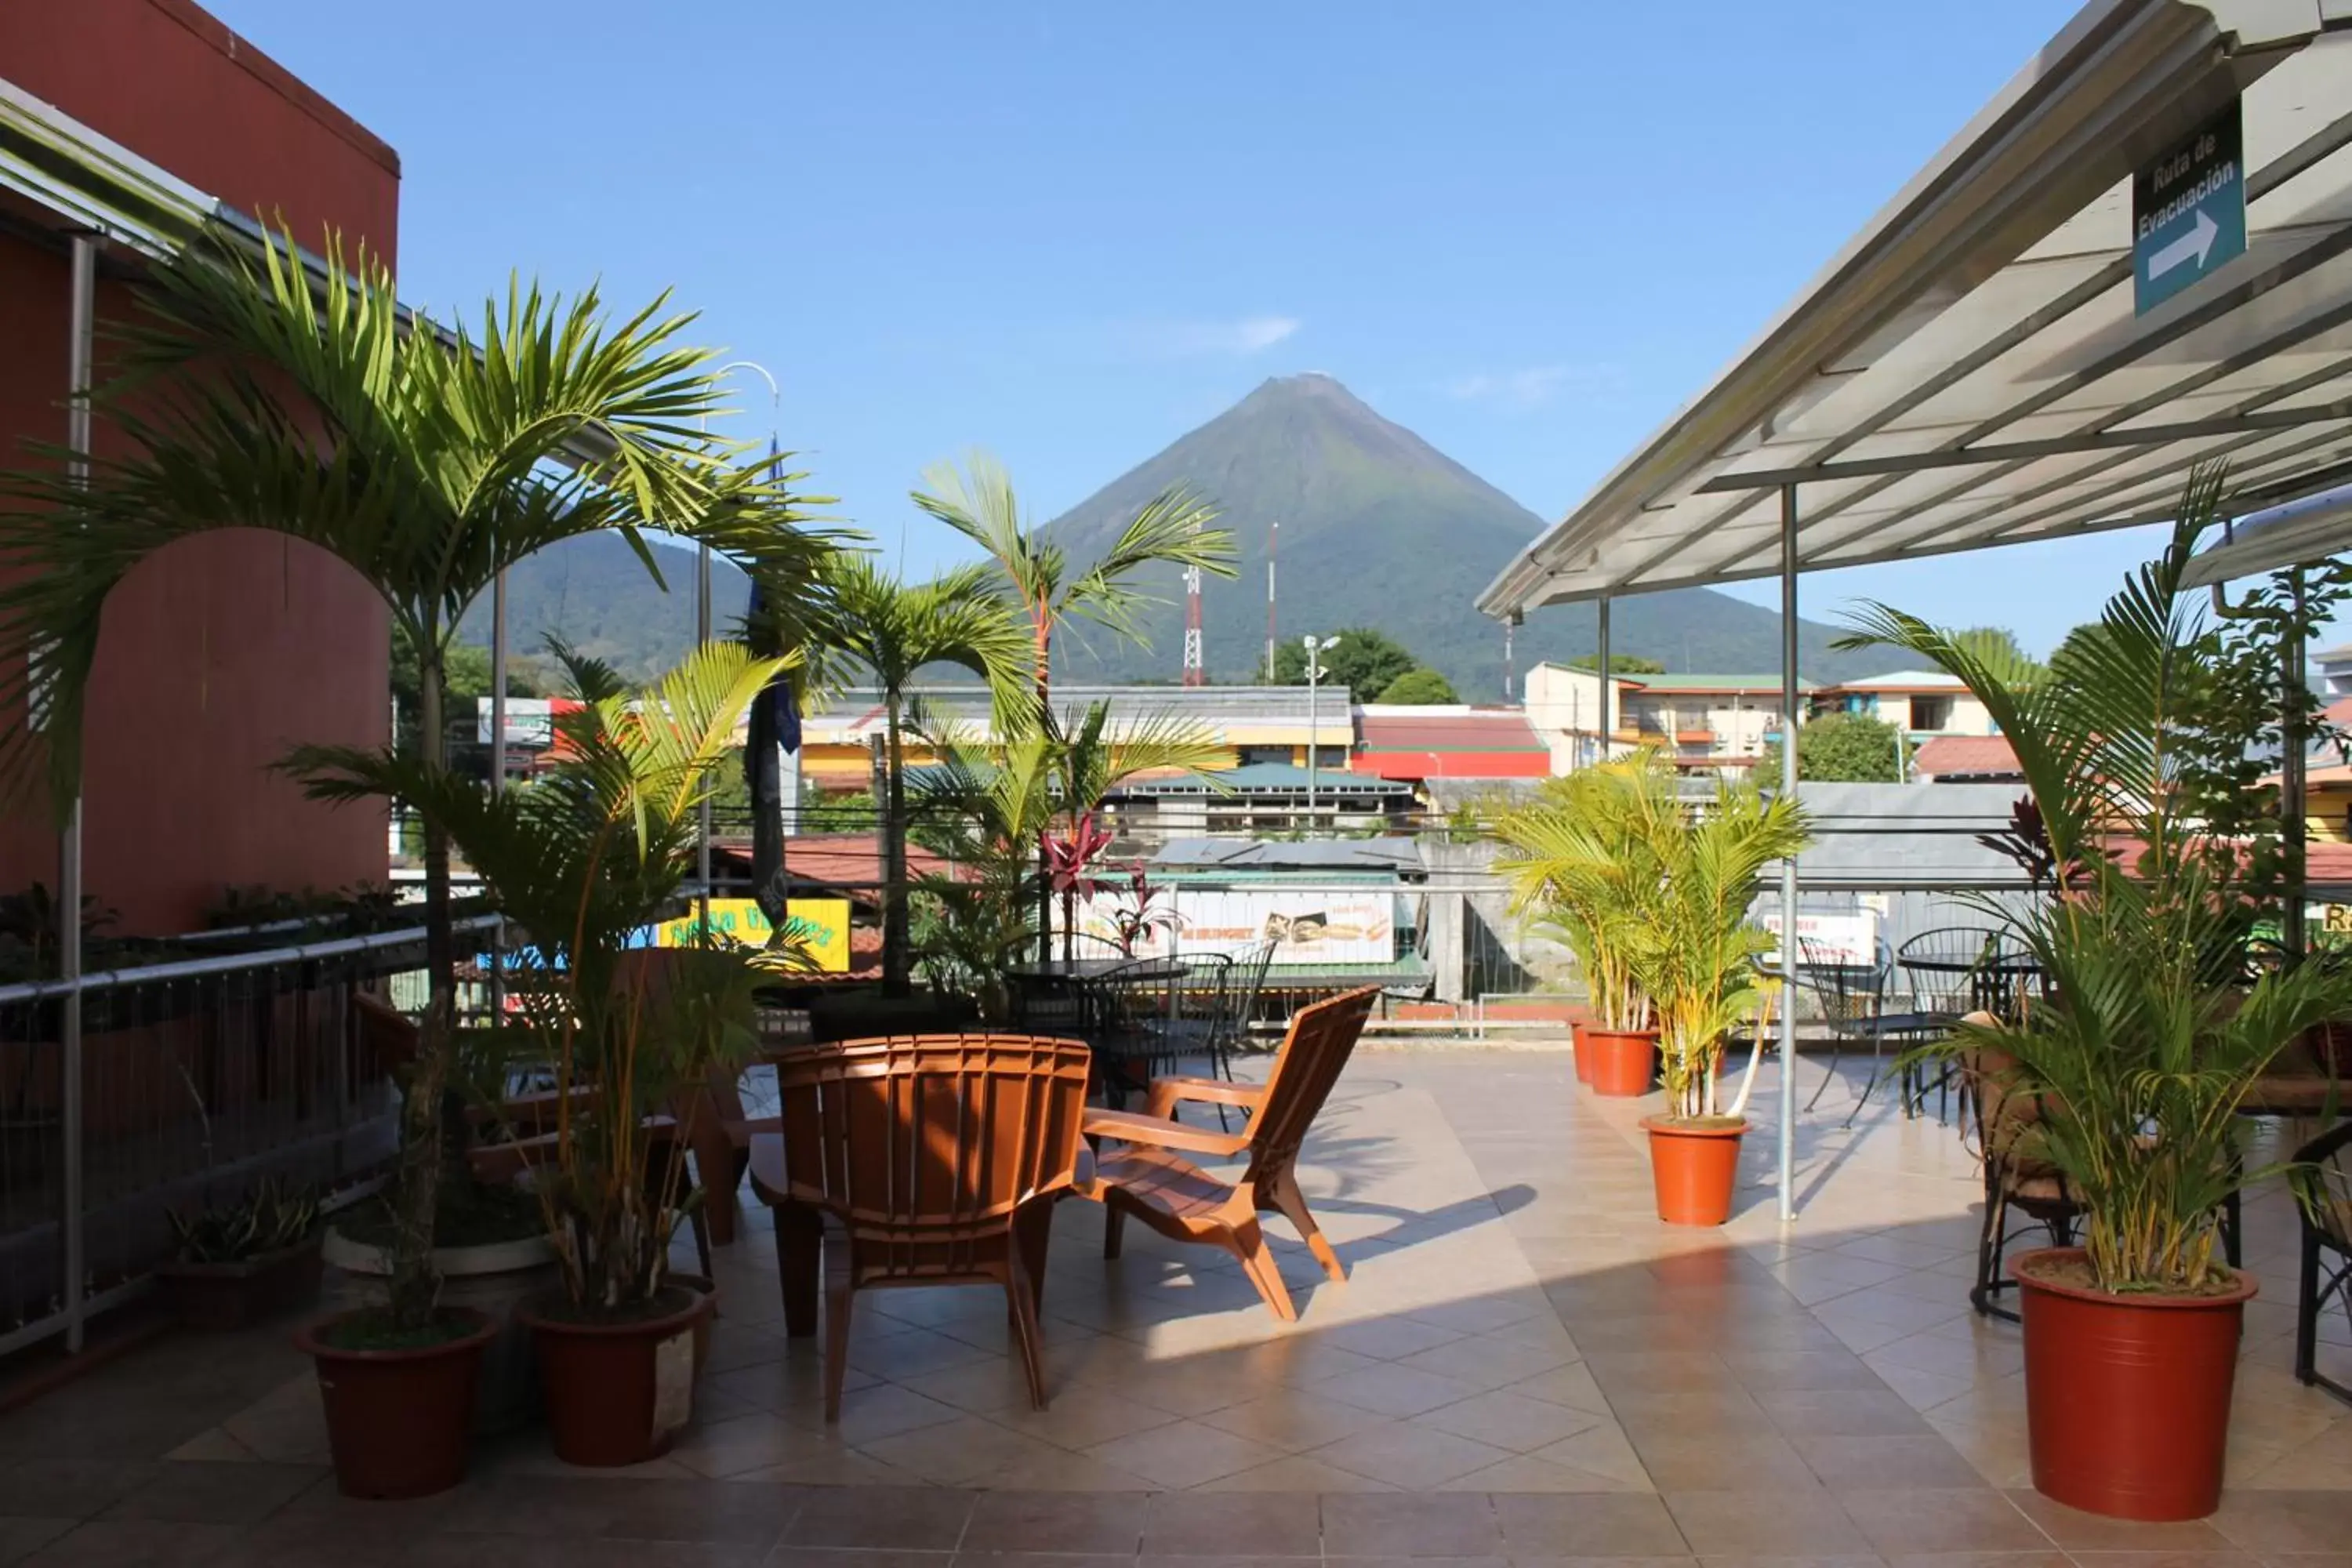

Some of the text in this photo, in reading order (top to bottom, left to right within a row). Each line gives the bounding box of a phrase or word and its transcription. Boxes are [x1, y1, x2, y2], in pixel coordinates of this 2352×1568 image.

[2154, 133, 2216, 193] Ruta de
[2139, 161, 2234, 241] Evacuación
[2323, 903, 2352, 932] R
